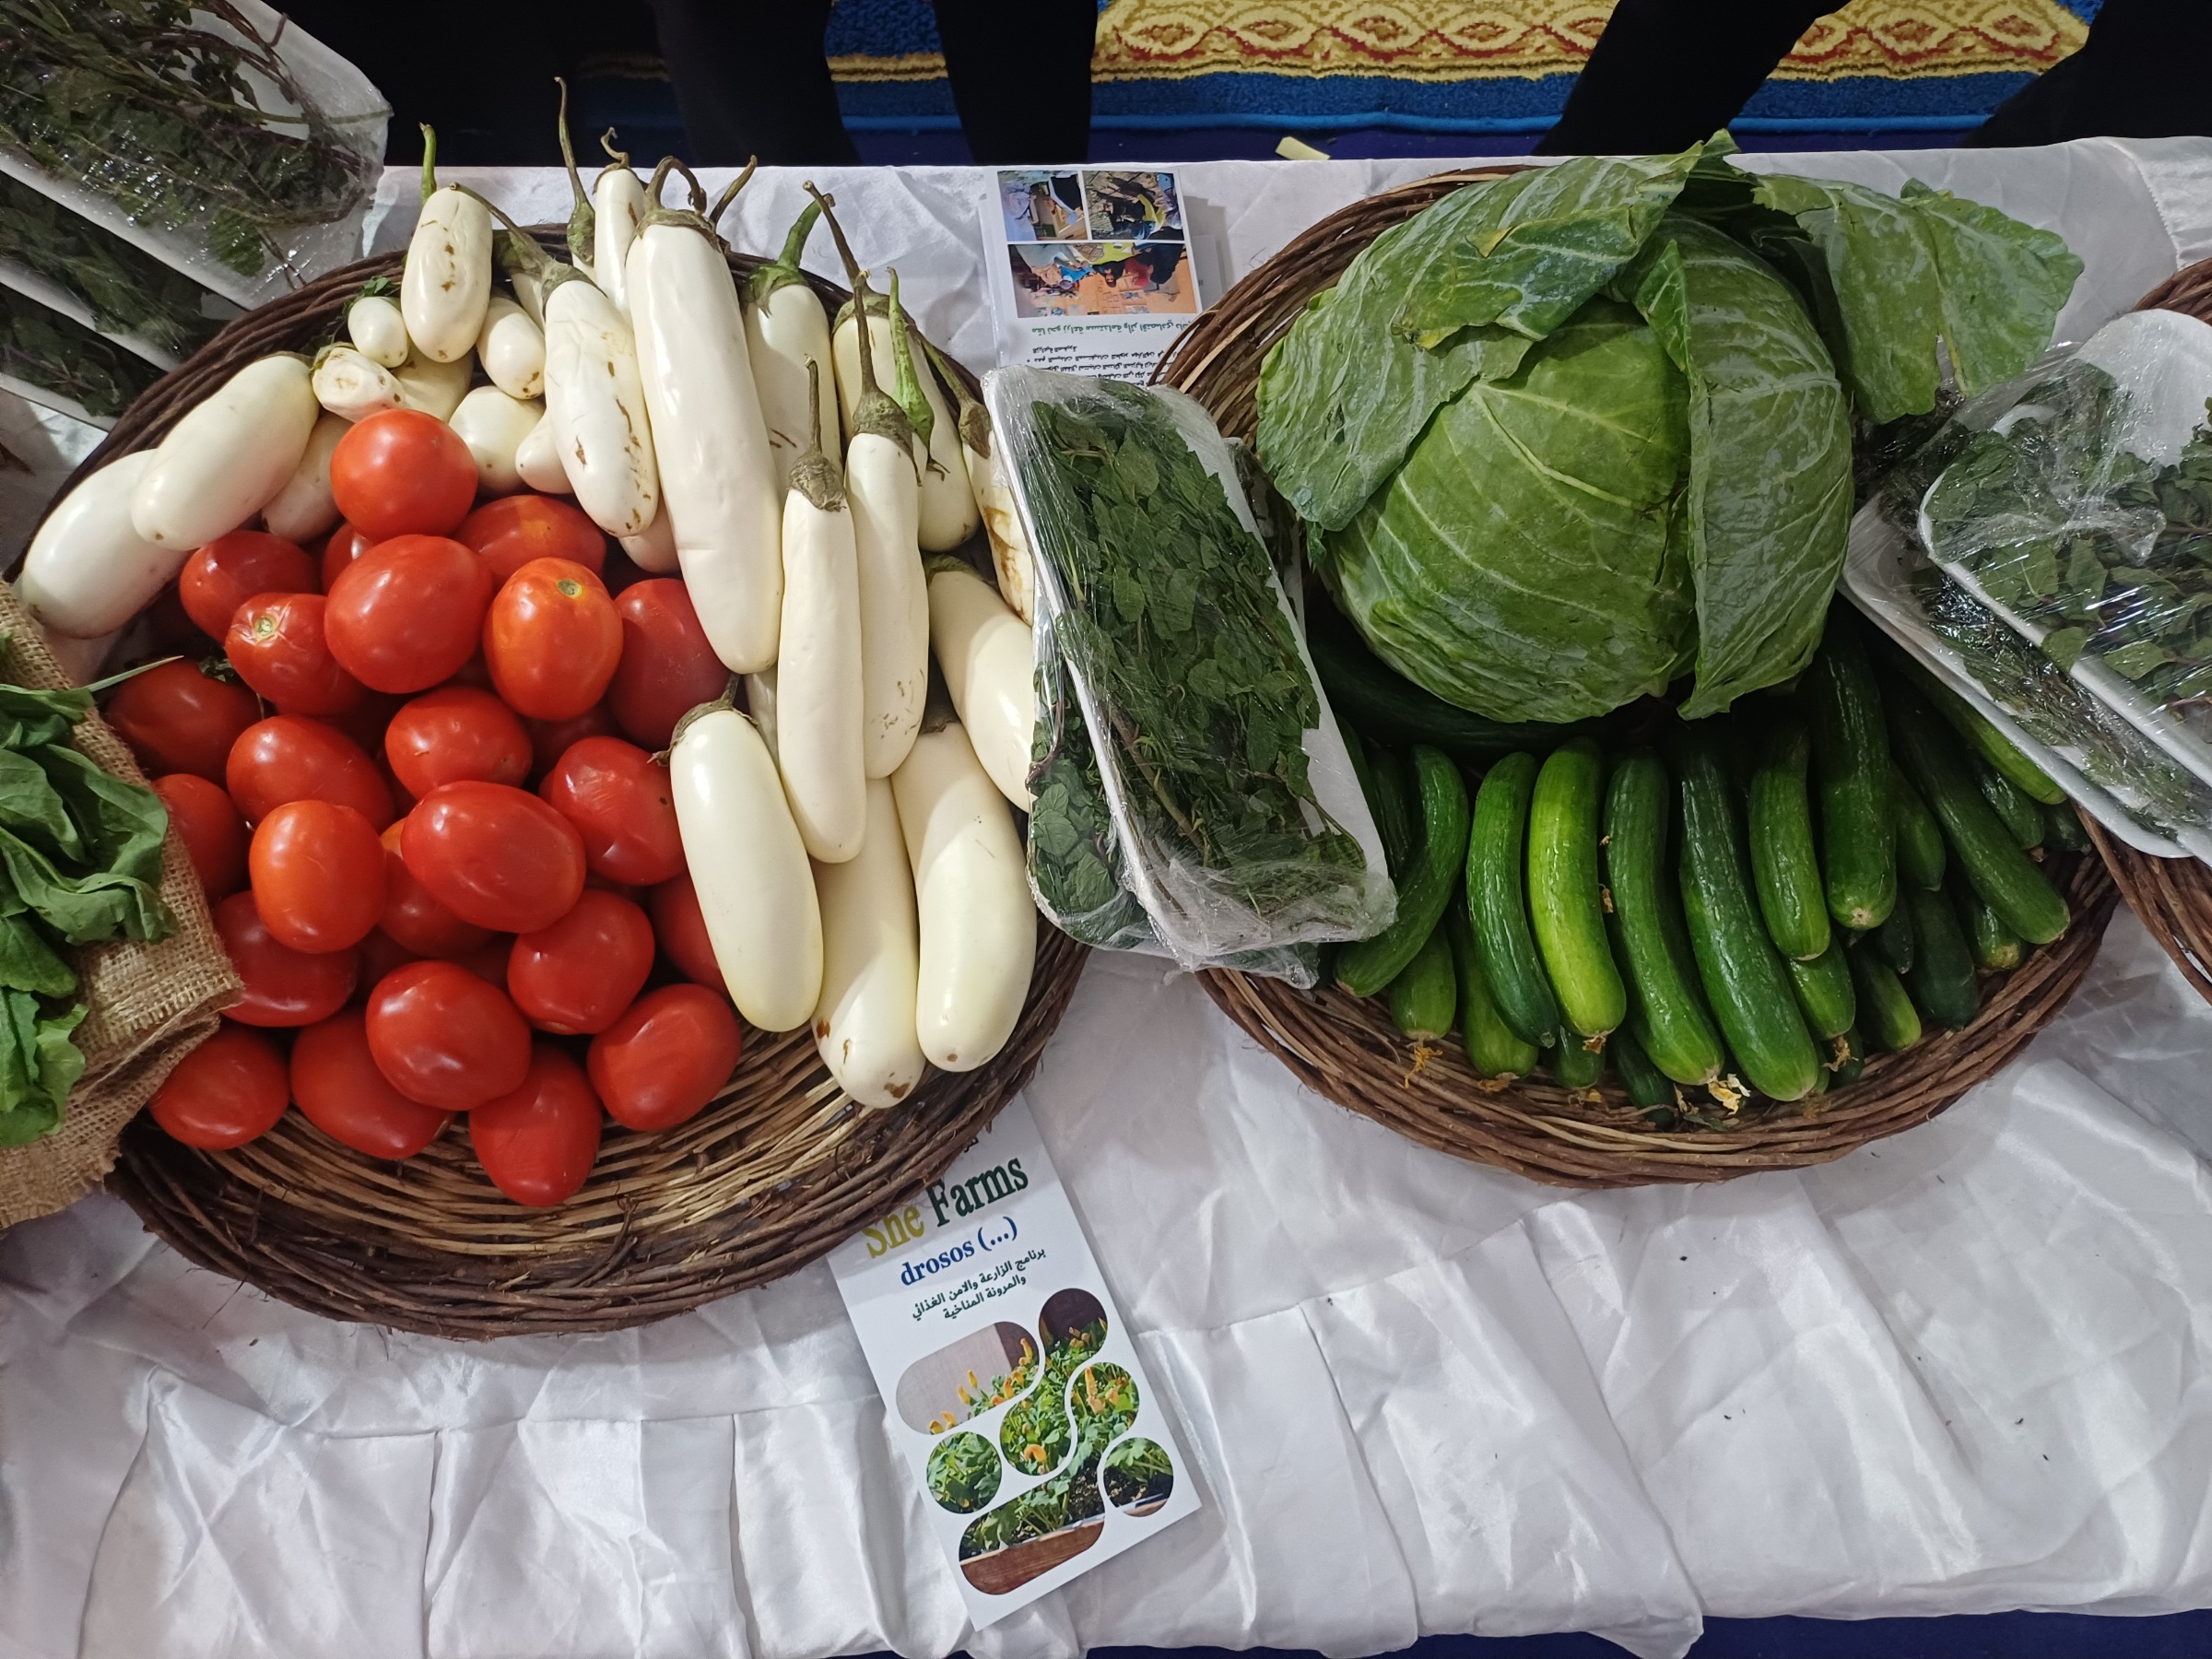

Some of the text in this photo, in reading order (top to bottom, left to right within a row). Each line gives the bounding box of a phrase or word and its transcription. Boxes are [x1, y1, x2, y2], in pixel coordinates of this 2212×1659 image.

[1047, 325, 1061, 335] نحو
[1063, 324, 1084, 335] زراعة
[1086, 324, 1123, 333] مستدامة
[1139, 319, 1174, 332] اقتصادي
[925, 1158, 1029, 1228] Farms
[900, 1241, 975, 1286] drosos
[1015, 1249, 1047, 1271] برنامج
[944, 1274, 1027, 1319] والمرونة المناخية
[948, 1279, 979, 1300] والامن
[912, 1292, 946, 1322] الغذائي
